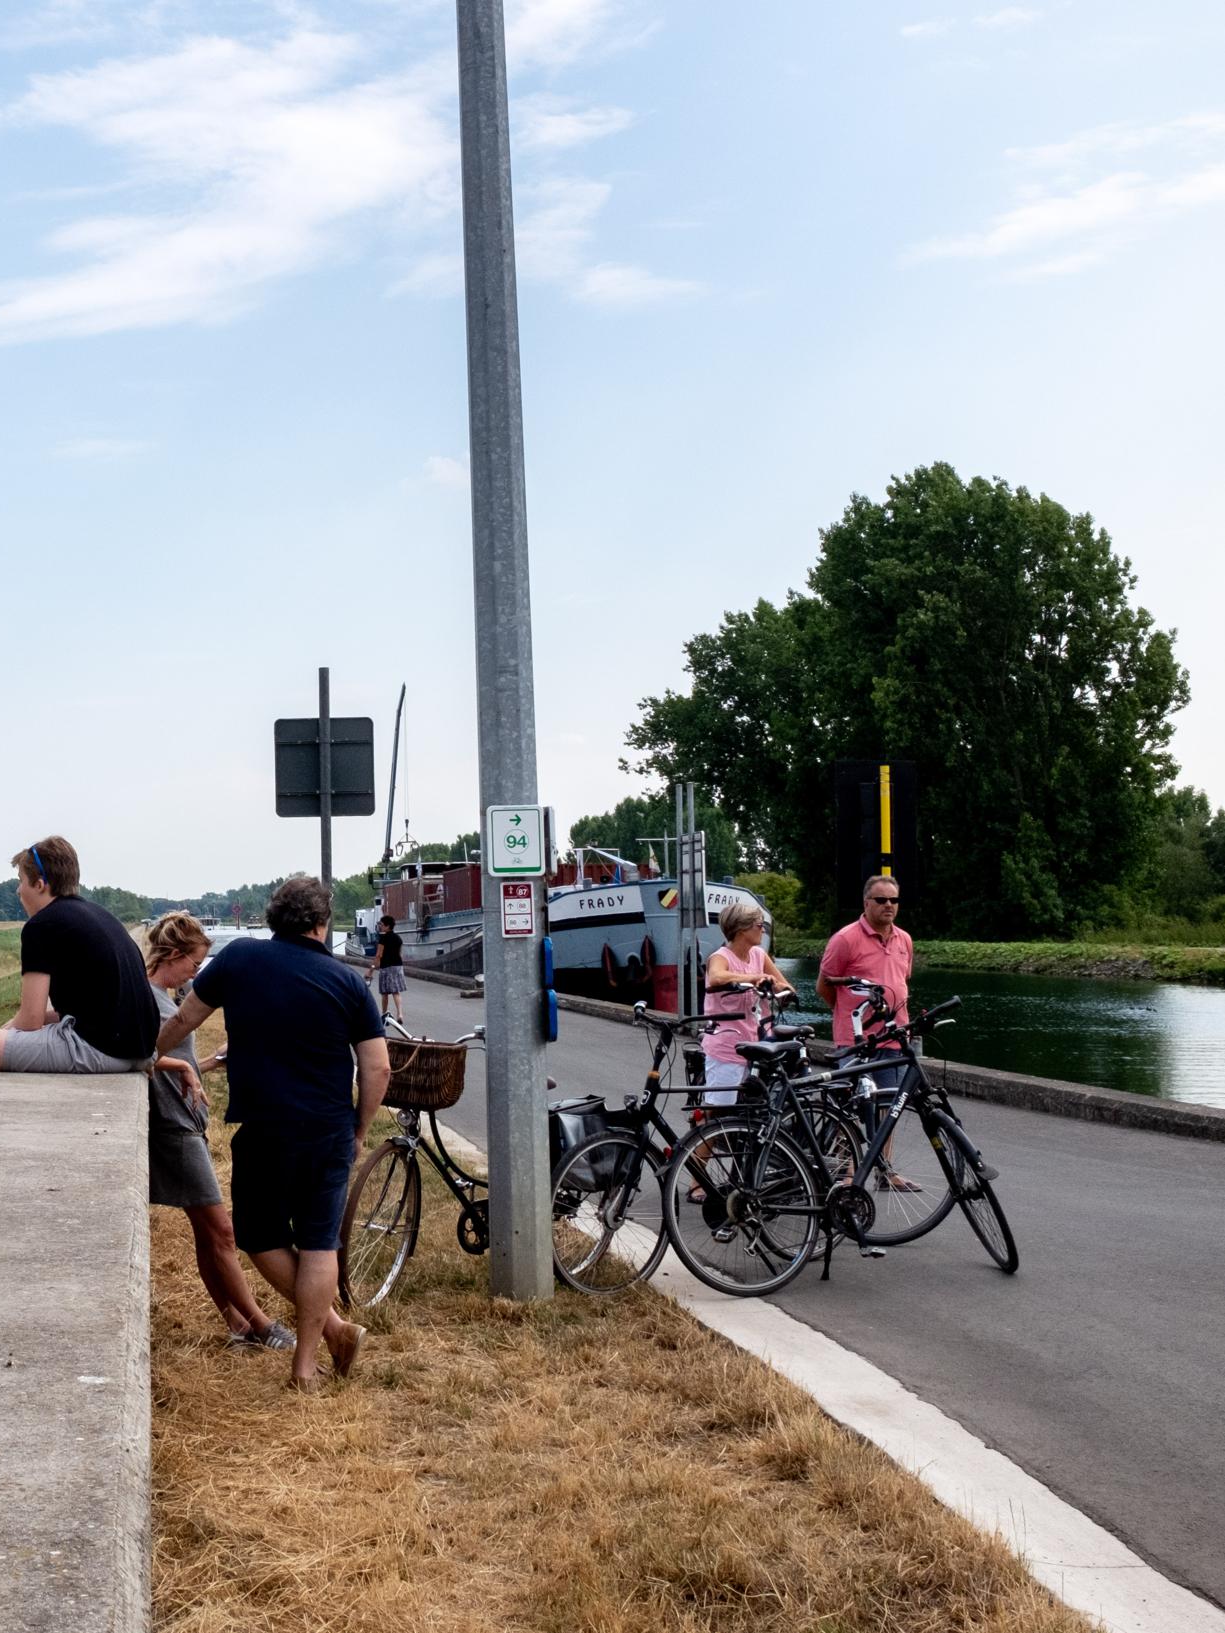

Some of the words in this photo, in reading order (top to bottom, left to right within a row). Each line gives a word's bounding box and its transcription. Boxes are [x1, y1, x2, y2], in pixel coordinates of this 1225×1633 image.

[506, 835, 527, 848] 94
[518, 888, 527, 897] 87
[579, 895, 624, 909] FRADY
[707, 893, 740, 905] FRADY
